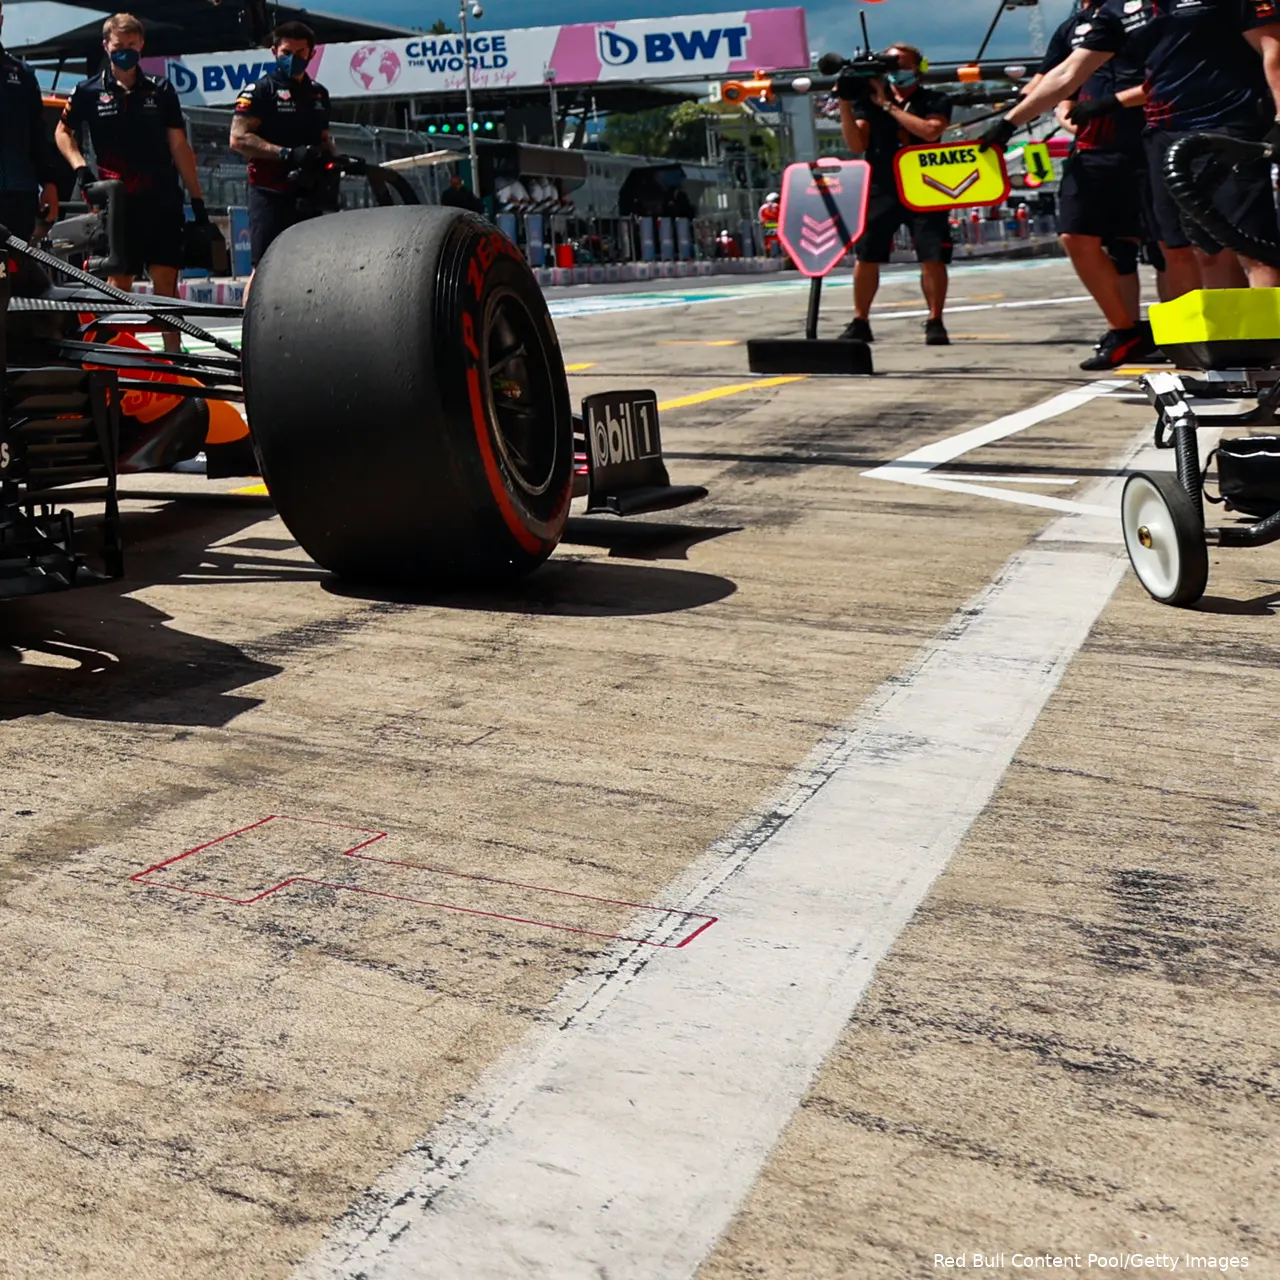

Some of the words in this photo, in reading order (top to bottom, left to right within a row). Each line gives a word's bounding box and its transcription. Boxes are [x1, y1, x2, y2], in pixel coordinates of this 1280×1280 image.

[405, 35, 507, 58] CHANGE
[644, 26, 748, 63] BWT
[408, 59, 425, 68] THE
[426, 53, 508, 73] WORLD
[918, 148, 976, 168] BRAKES
[590, 401, 635, 469] obil
